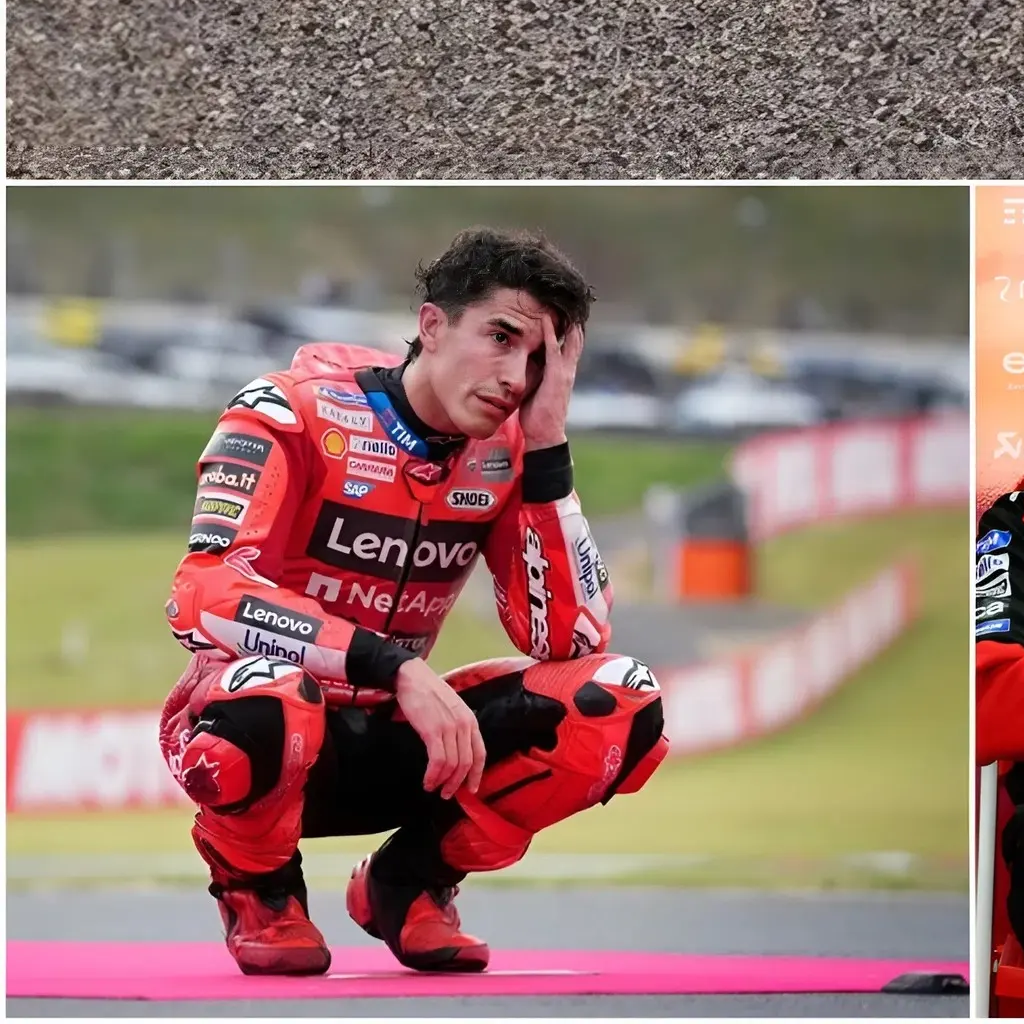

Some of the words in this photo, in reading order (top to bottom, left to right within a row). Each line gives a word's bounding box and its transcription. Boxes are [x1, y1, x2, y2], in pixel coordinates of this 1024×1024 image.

[391, 421, 417, 452] TIM
[325, 516, 478, 569] Lenovo
[242, 601, 313, 635] Lenovo
